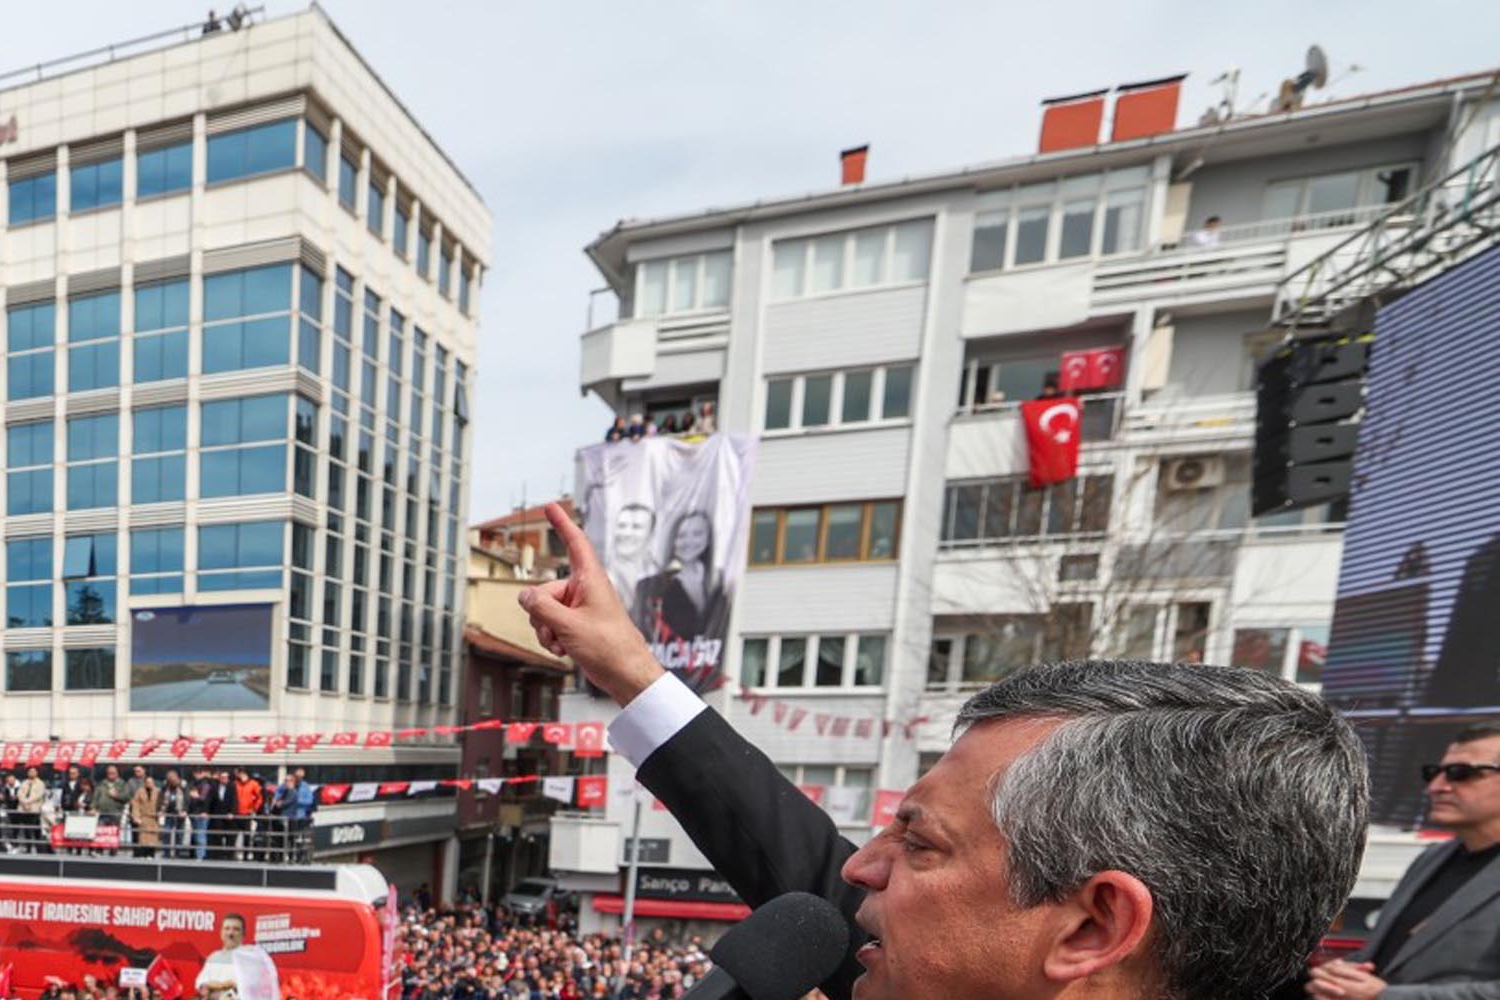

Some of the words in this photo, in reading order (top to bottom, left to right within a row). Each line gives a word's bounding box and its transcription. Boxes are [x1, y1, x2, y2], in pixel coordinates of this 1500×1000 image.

[640, 875, 690, 893] Sanço
[42, 901, 111, 924] İRADESİNE
[112, 905, 155, 927] SAHİP
[157, 909, 216, 931] ÇIKIYOR
